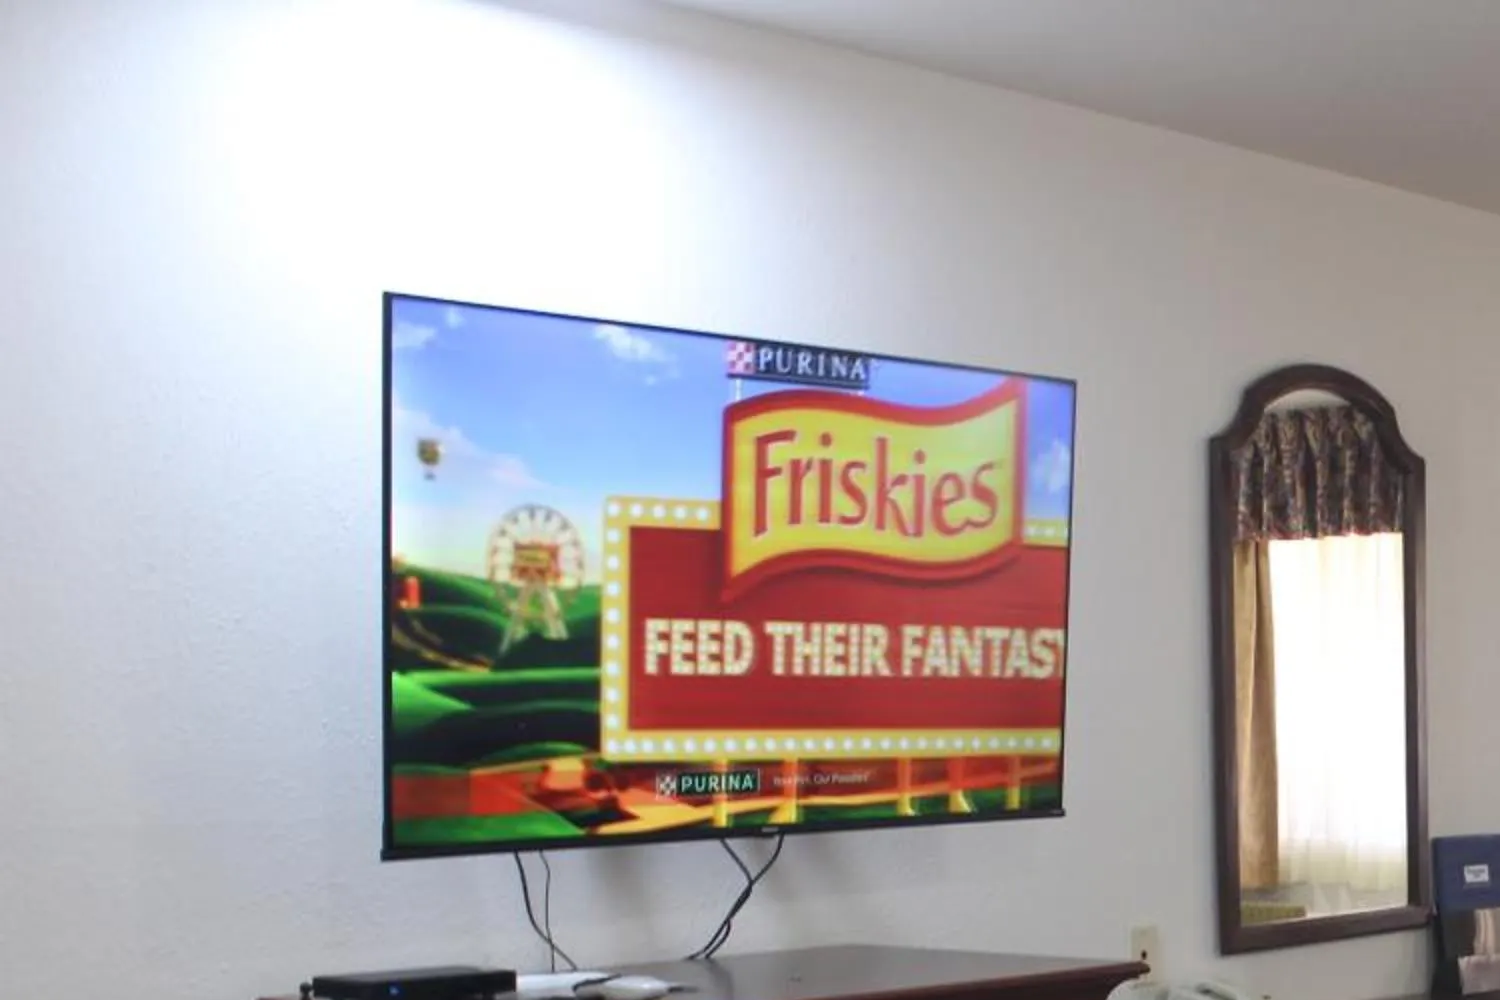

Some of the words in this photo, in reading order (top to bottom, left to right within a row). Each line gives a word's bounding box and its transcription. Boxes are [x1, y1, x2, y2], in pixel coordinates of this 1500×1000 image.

[758, 346, 866, 380] PURINA
[753, 429, 1000, 538] Friskies
[644, 617, 755, 676] FEED
[763, 620, 893, 677] THEIR
[681, 773, 754, 792] PURINA
